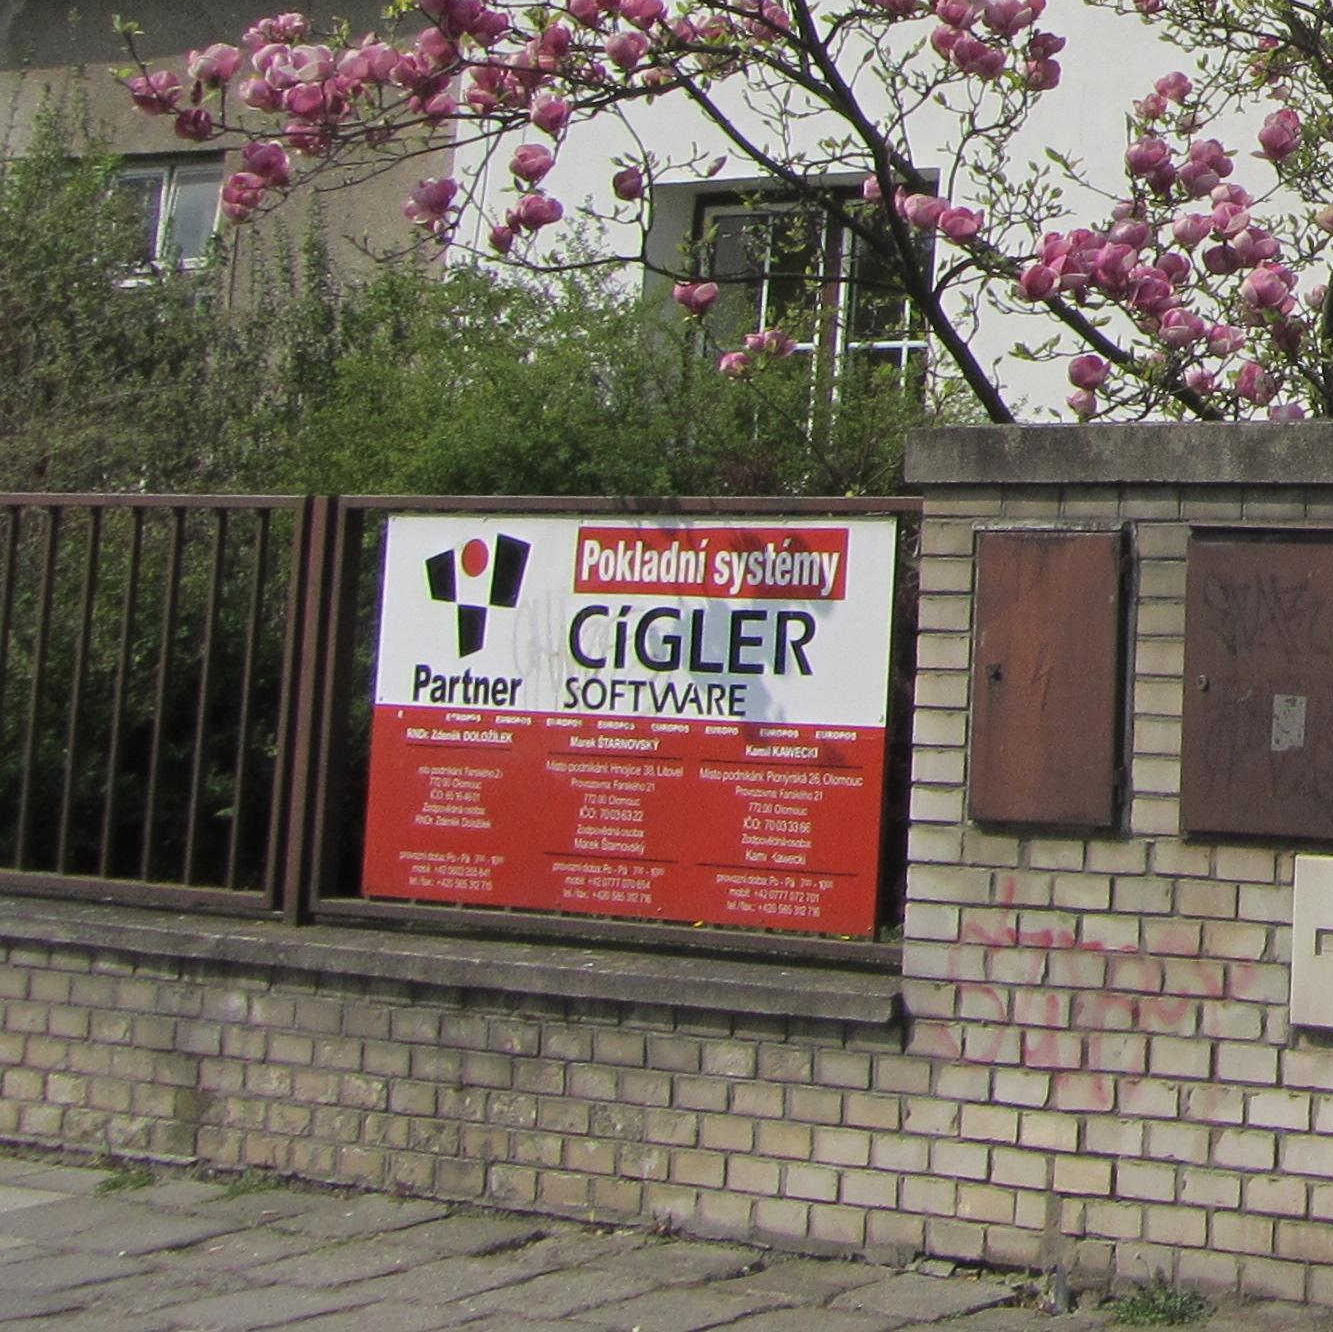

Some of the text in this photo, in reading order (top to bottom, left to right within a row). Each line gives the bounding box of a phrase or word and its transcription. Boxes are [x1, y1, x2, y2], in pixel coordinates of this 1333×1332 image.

[581, 537, 840, 596] Pokladní systémy
[412, 663, 523, 707] Partner
[563, 676, 747, 716] SOFTWARE
